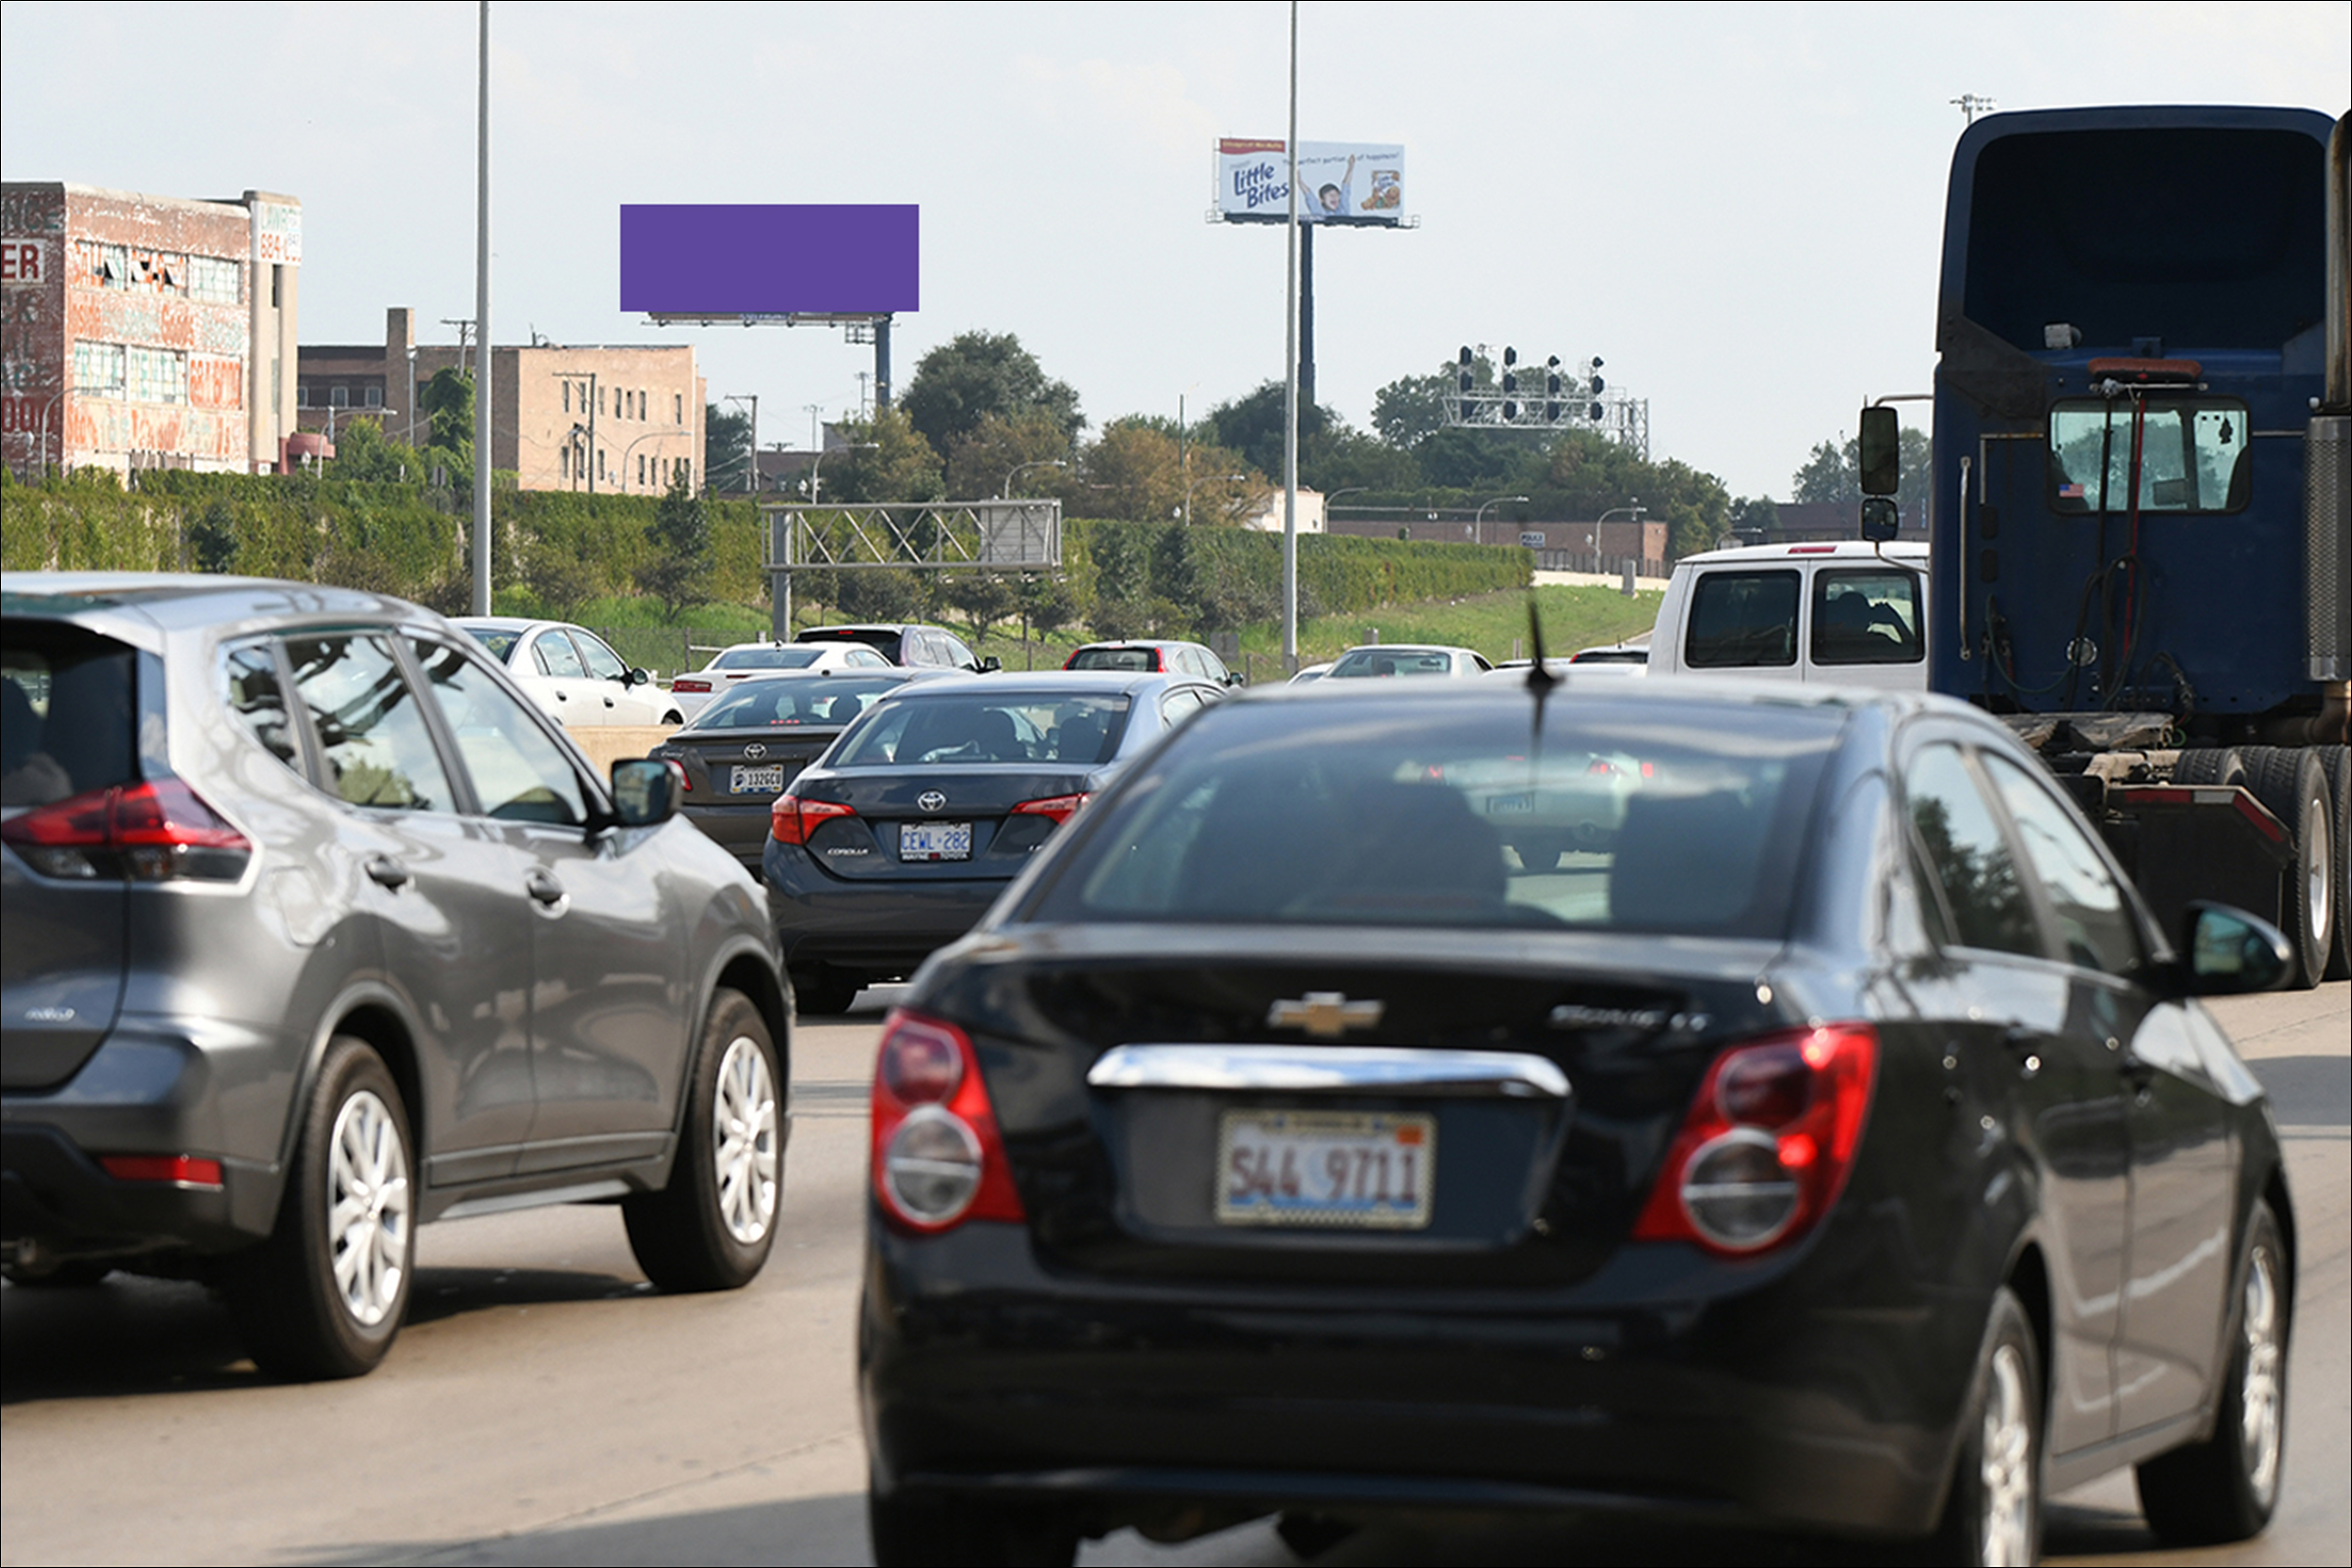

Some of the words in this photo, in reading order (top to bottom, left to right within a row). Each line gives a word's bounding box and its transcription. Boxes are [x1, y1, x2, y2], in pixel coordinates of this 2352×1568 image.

[1234, 162, 1275, 196] Little
[1247, 182, 1290, 209] Bites
[944, 831, 970, 851] 282
[1230, 1146, 1301, 1197] S44
[1326, 1147, 1417, 1201] 9711
